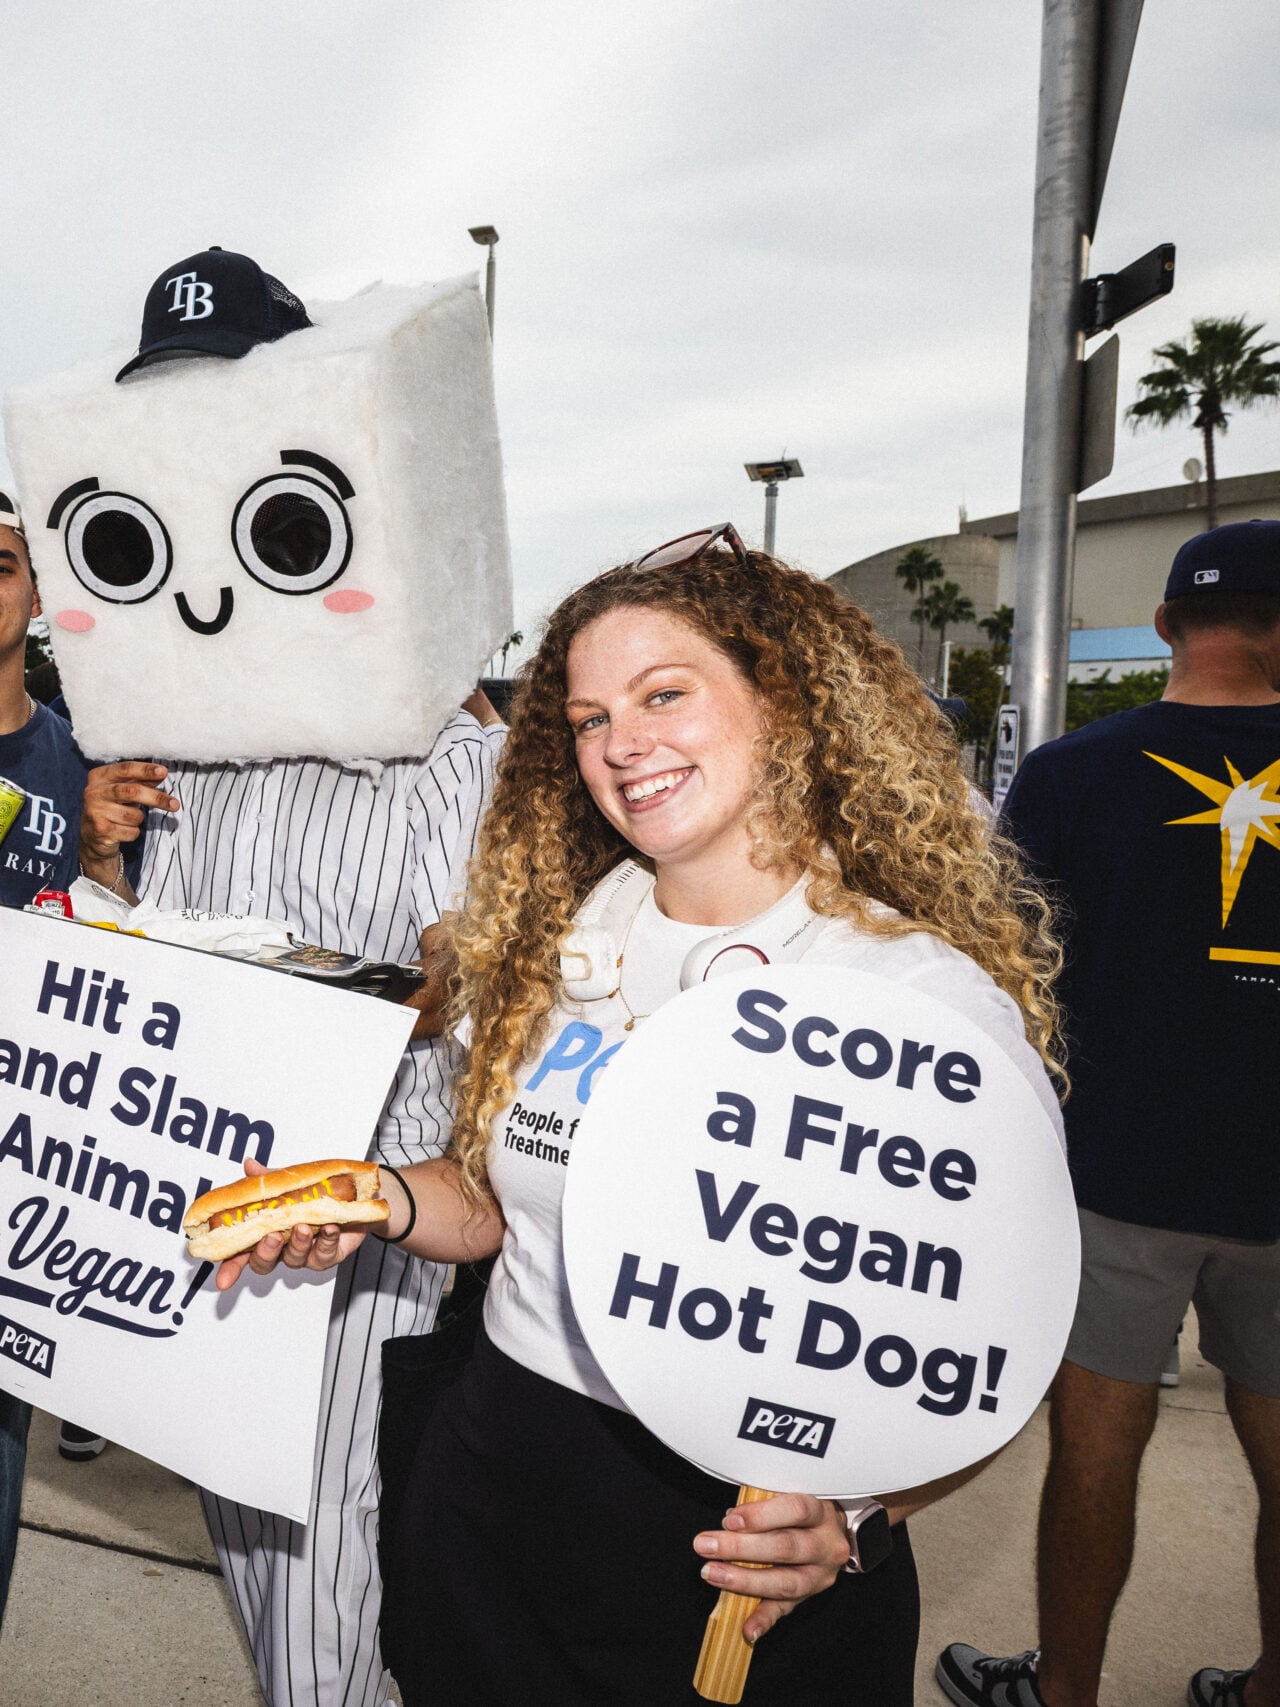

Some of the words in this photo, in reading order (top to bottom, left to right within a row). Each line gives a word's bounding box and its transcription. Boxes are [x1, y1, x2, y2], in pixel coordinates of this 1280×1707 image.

[164, 271, 214, 322] TB
[23, 791, 67, 856] TB
[37, 960, 129, 1034] Hit
[142, 1001, 181, 1050] a
[1234, 975, 1275, 984] TAMPA
[732, 989, 981, 1103] Score
[111, 1067, 275, 1167] Slam
[504, 1126, 570, 1166] Treatme
[508, 1102, 563, 1135] People
[706, 1091, 756, 1148] a
[785, 1095, 977, 1201] Free
[7, 1196, 214, 1326] Vegan!
[695, 1169, 963, 1302] Vegan
[609, 1253, 774, 1354] Hot
[796, 1300, 1008, 1417] Dog!
